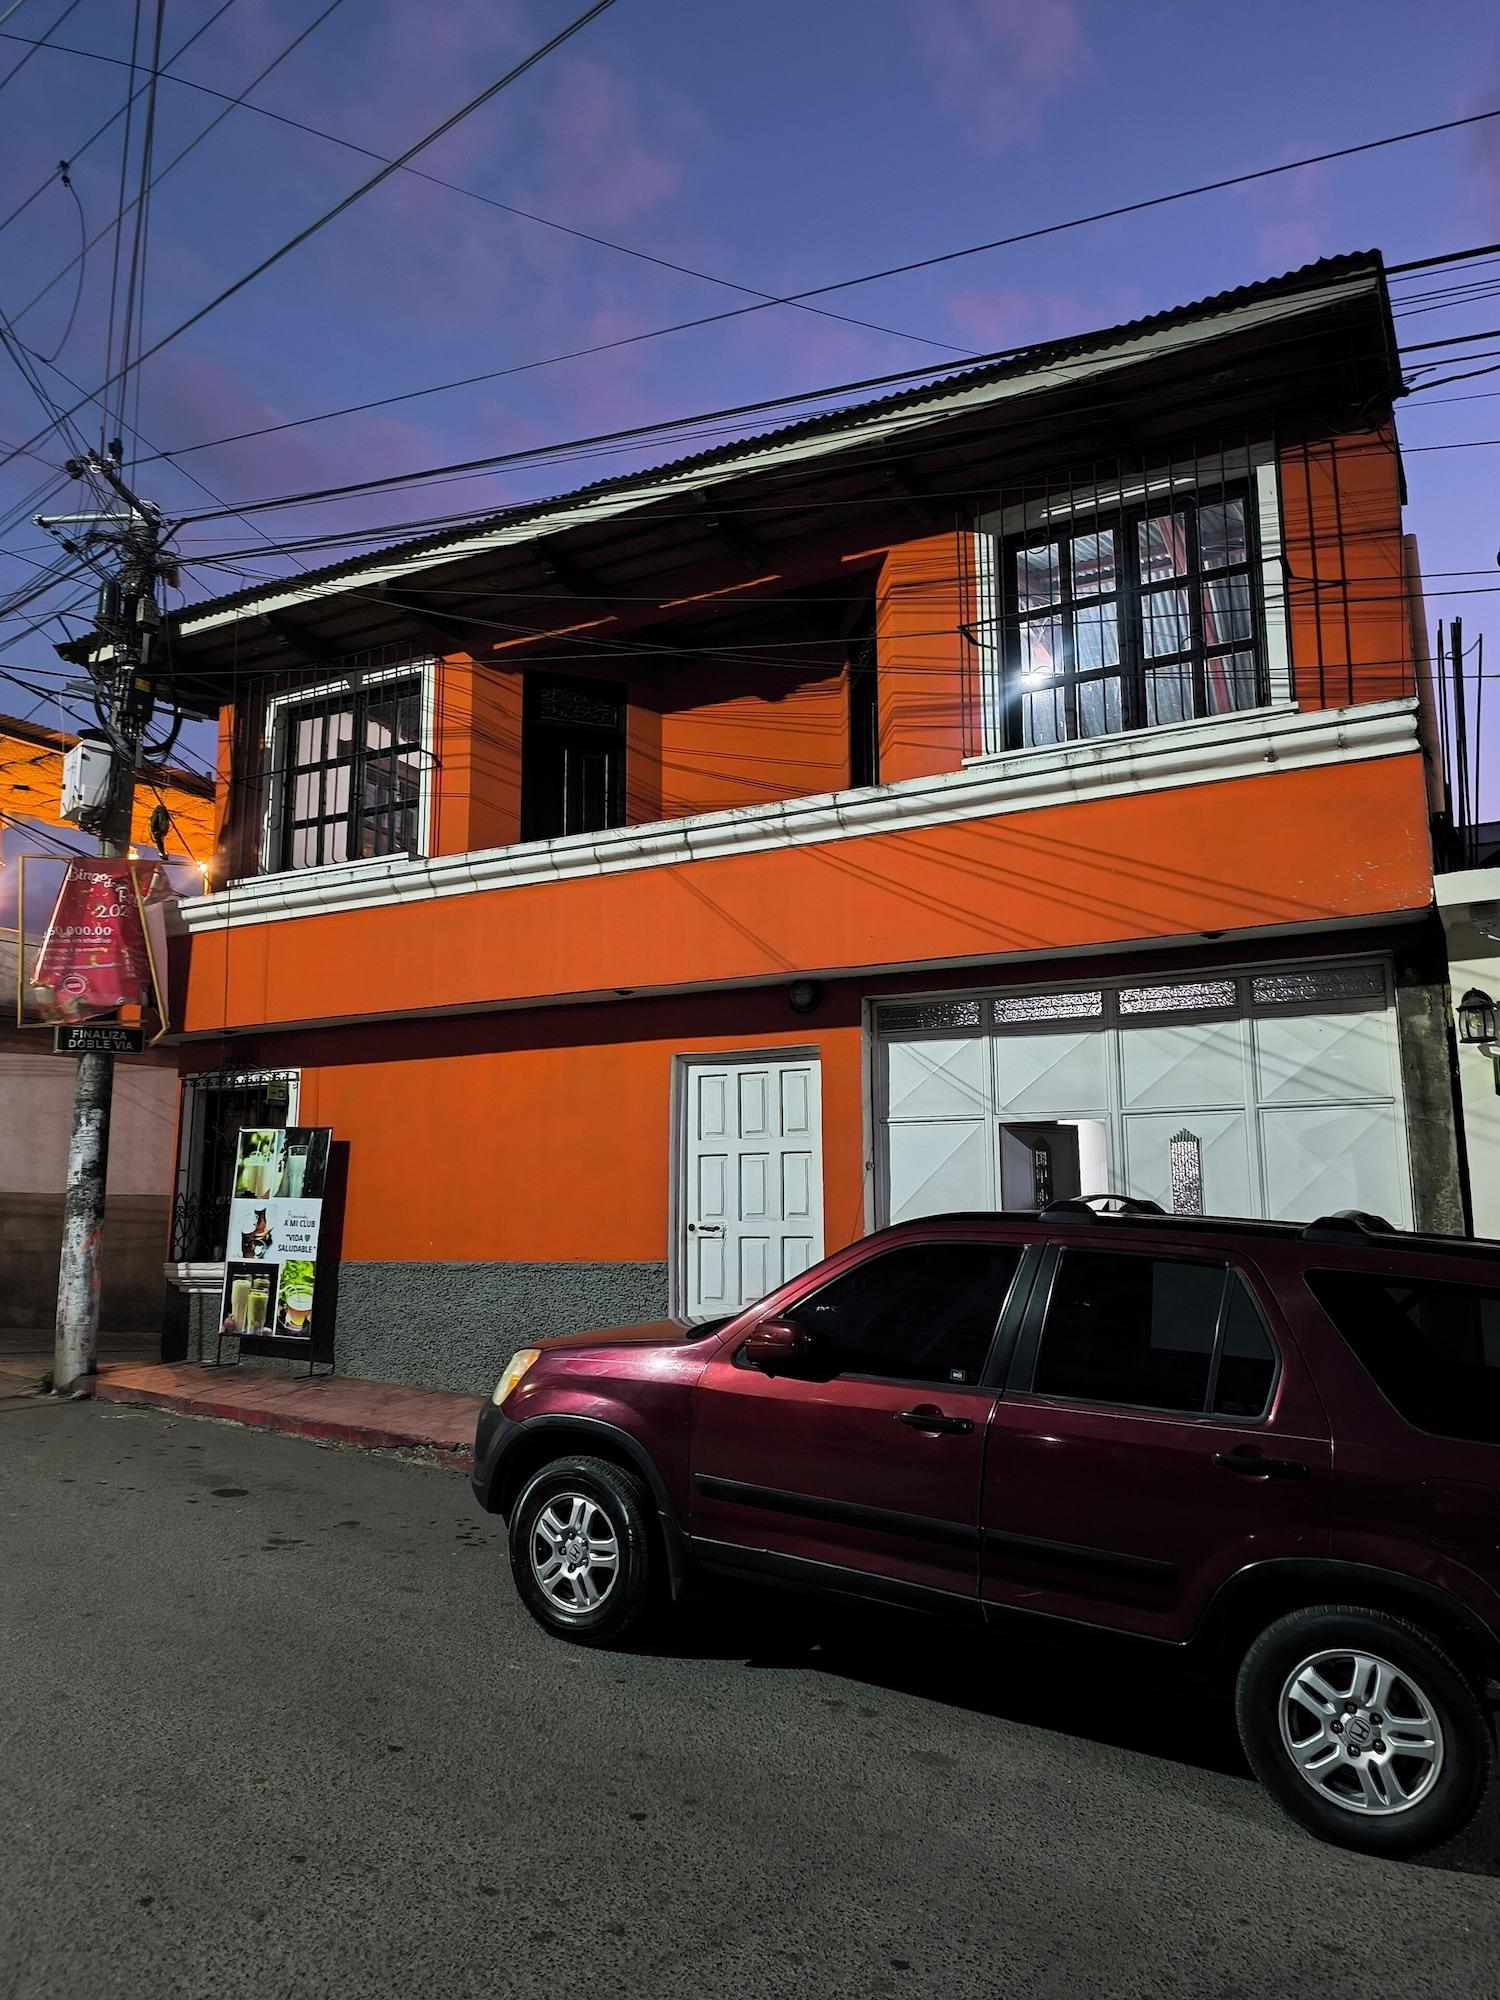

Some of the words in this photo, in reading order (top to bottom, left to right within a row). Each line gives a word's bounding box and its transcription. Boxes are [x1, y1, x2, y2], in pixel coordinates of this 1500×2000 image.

[67, 866, 110, 885] Bingo
[72, 1029, 127, 1040] FINALIZA
[68, 1039, 111, 1049] DOBLE
[290, 1219, 298, 1227] MI
[300, 1220, 316, 1228] CLUB
